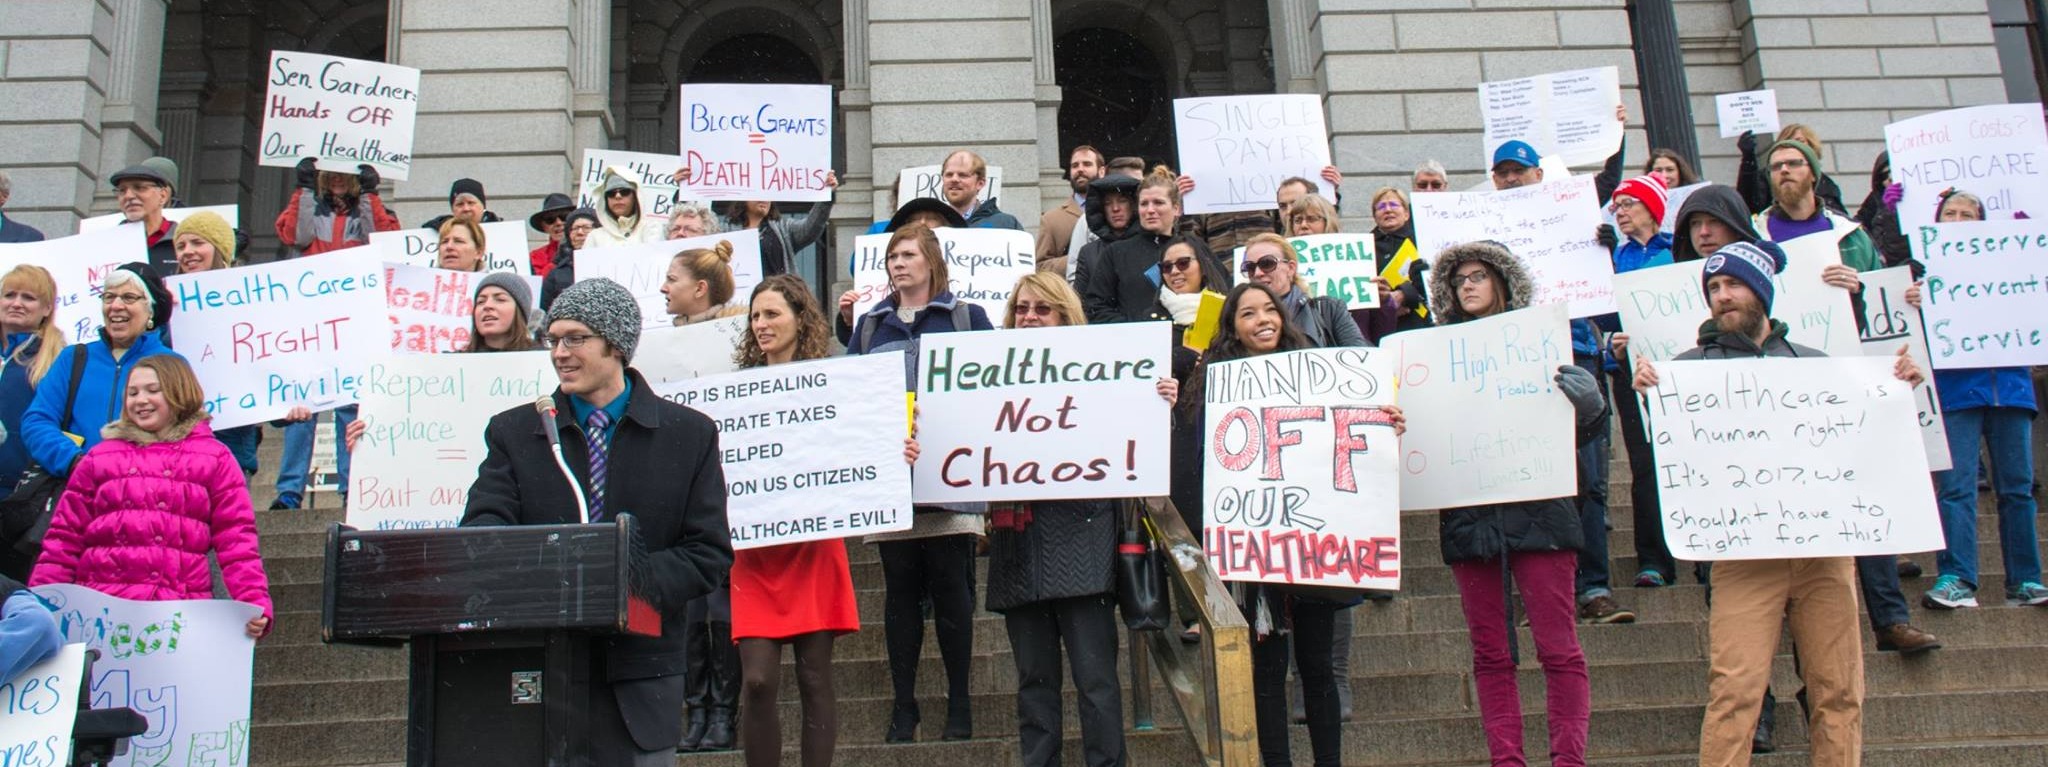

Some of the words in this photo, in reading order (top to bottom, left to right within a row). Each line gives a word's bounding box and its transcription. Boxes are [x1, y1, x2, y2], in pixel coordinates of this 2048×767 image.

[272, 57, 312, 89] Sen.
[320, 61, 417, 102] Gardner:
[270, 94, 331, 119] Hands
[347, 106, 393, 127] Off
[691, 103, 752, 132] BLOCK
[756, 104, 827, 136] GRANTS
[1185, 100, 1317, 142] SINGLE
[265, 132, 304, 157] Our
[320, 131, 410, 165] Healthcare
[1214, 135, 1319, 167] PAYER
[1891, 125, 1952, 154] Control
[1969, 115, 2029, 140] Costs?
[687, 150, 750, 188] DEATH
[760, 148, 826, 191] PANELS
[1901, 153, 2039, 187] MEDICARE
[1987, 189, 2012, 211] all
[944, 240, 1012, 277] Repeal
[1919, 225, 2048, 260] Preserve
[179, 273, 289, 312] Health
[298, 271, 356, 298] Care
[232, 317, 351, 364] RIGHT
[1801, 305, 1832, 350] my
[927, 347, 1156, 393] Healthcare
[1207, 350, 1377, 405] HANDS
[1450, 337, 1498, 394] High
[203, 393, 229, 415] ot
[239, 393, 256, 409] a
[269, 367, 363, 407] Privile
[370, 363, 465, 413] Repeal
[489, 369, 542, 398] and
[703, 387, 719, 402] IS
[725, 373, 828, 400] REPEALING
[1657, 371, 1848, 416] Healthcare
[1865, 384, 1888, 399] is
[714, 413, 771, 434] ORATE
[776, 405, 837, 425] TAXES
[995, 396, 1079, 433] Not
[1657, 431, 1672, 445] a
[1692, 420, 1771, 445] human
[1795, 410, 1866, 448] right!
[360, 414, 457, 457] Replace
[1213, 405, 1397, 493] OFF
[359, 476, 419, 512] Bait
[430, 486, 469, 507] an
[763, 476, 787, 492] US
[793, 465, 877, 489] CITIZENS
[1661, 462, 1709, 489] It's
[1814, 467, 1856, 482] we
[731, 516, 828, 542] ALTHCARE
[850, 509, 897, 528] EVIL!
[1214, 486, 1326, 531] OUR
[1778, 499, 1832, 520] have
[1852, 496, 1884, 517] to
[1204, 525, 1398, 584] HEALTHCARE
[1686, 529, 1752, 553] fight
[1776, 523, 1820, 544] for
[1838, 519, 1892, 542] this!
